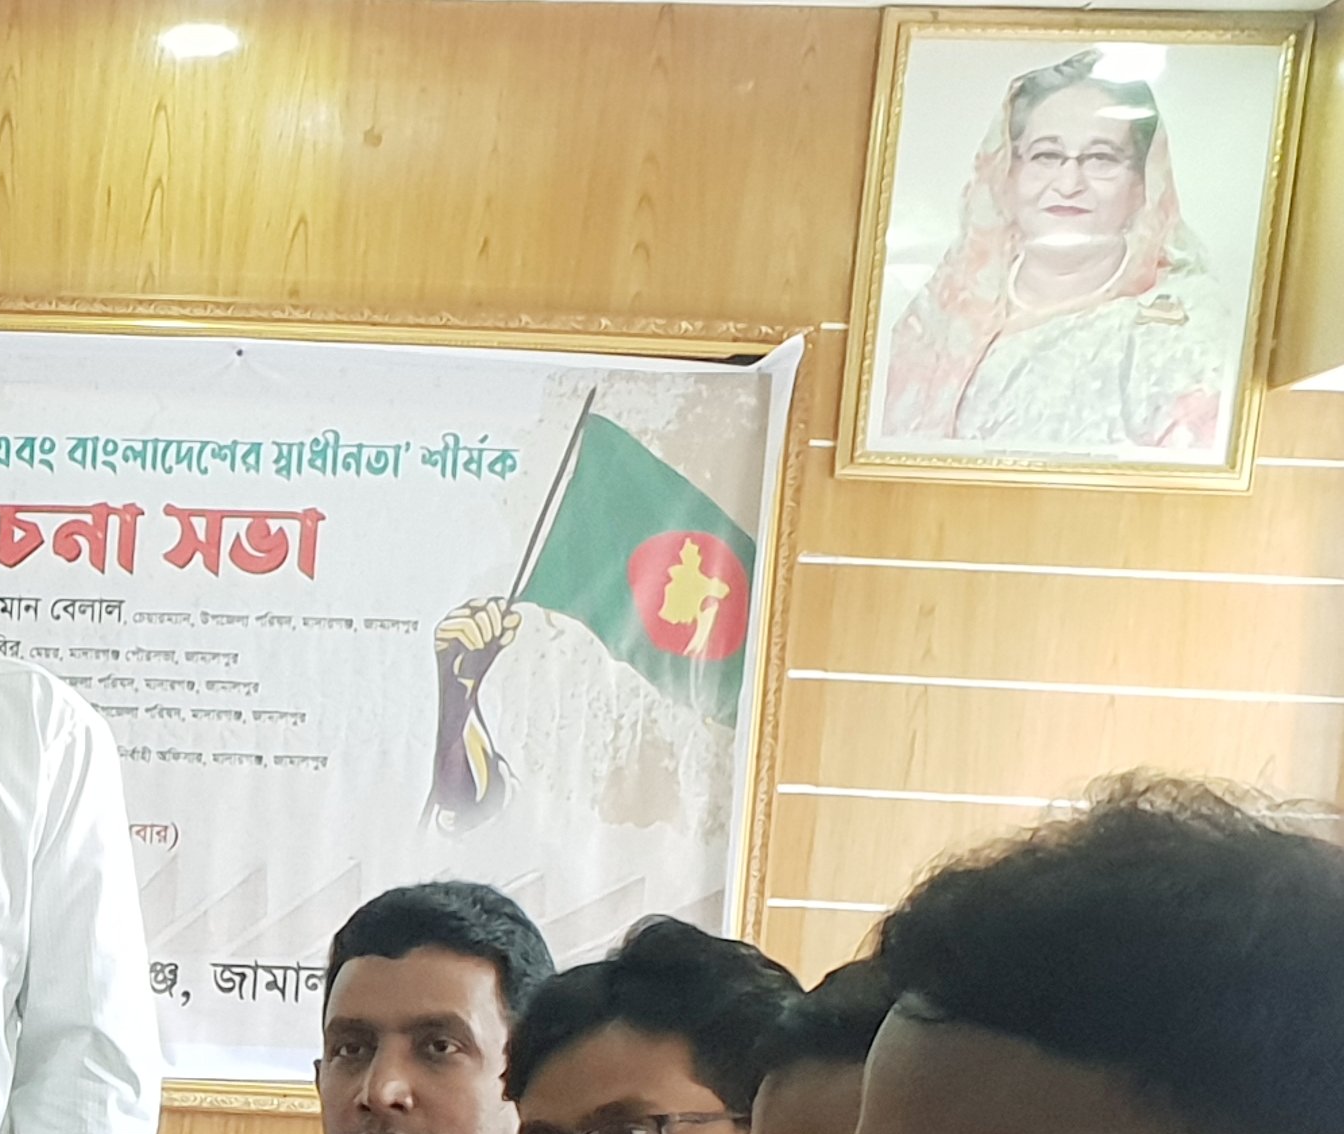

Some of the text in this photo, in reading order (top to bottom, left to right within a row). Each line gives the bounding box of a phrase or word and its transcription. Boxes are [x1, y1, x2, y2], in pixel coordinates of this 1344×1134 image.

[65, 435, 263, 476] বাংলাদেশের
[420, 432, 520, 480] শীর্ষক
[162, 503, 326, 581] সভা
[49, 597, 128, 626] বেলাল,
